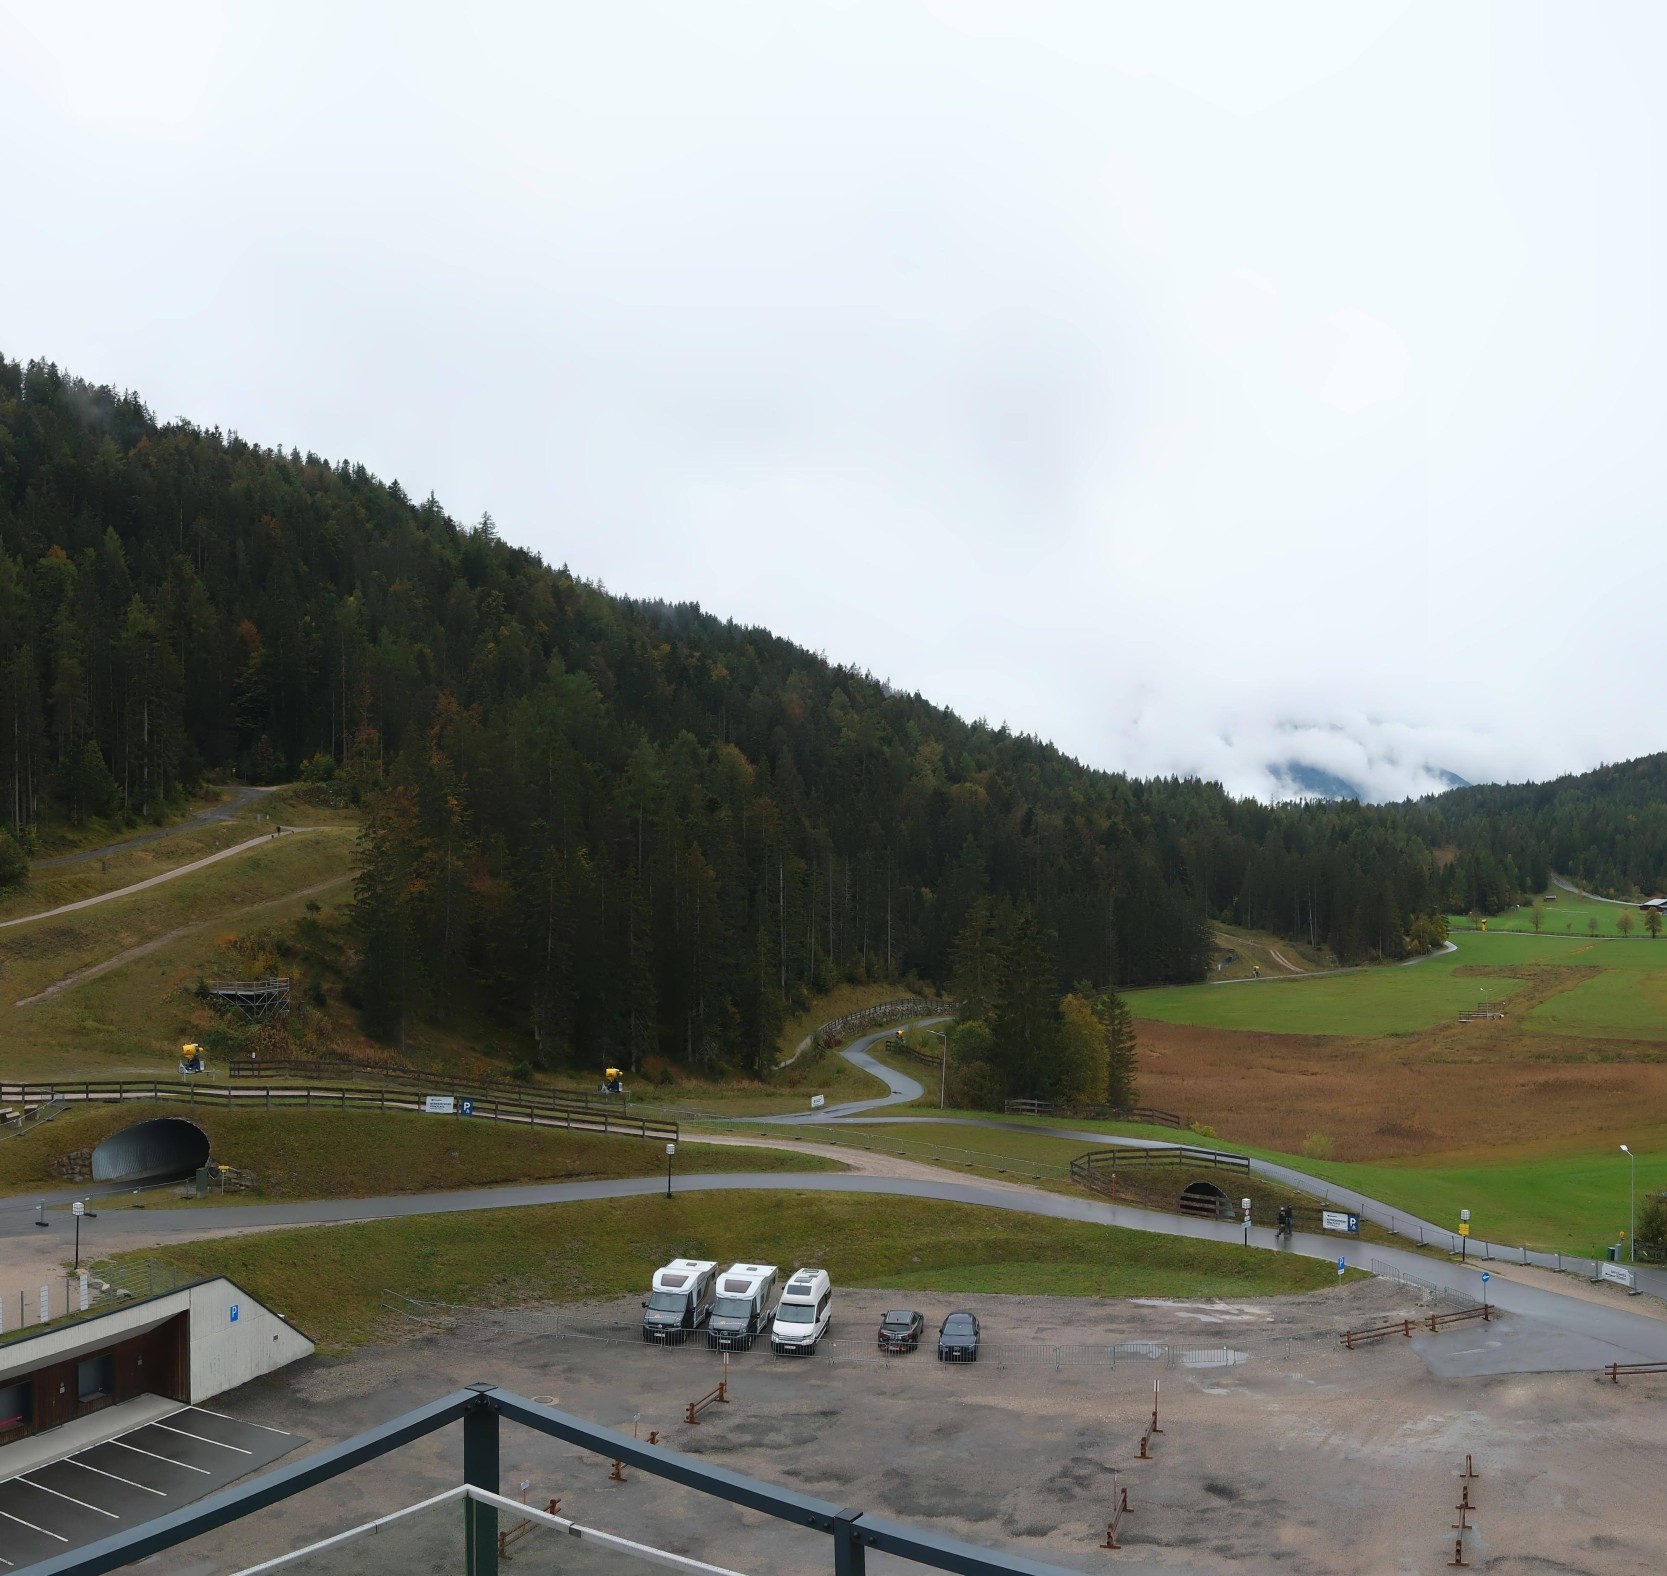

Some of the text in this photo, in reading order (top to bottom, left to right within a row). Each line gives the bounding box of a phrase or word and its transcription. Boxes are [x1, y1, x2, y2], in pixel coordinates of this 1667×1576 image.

[463, 1102, 471, 1111] P
[1349, 1217, 1357, 1227] P
[232, 1306, 237, 1318] P
